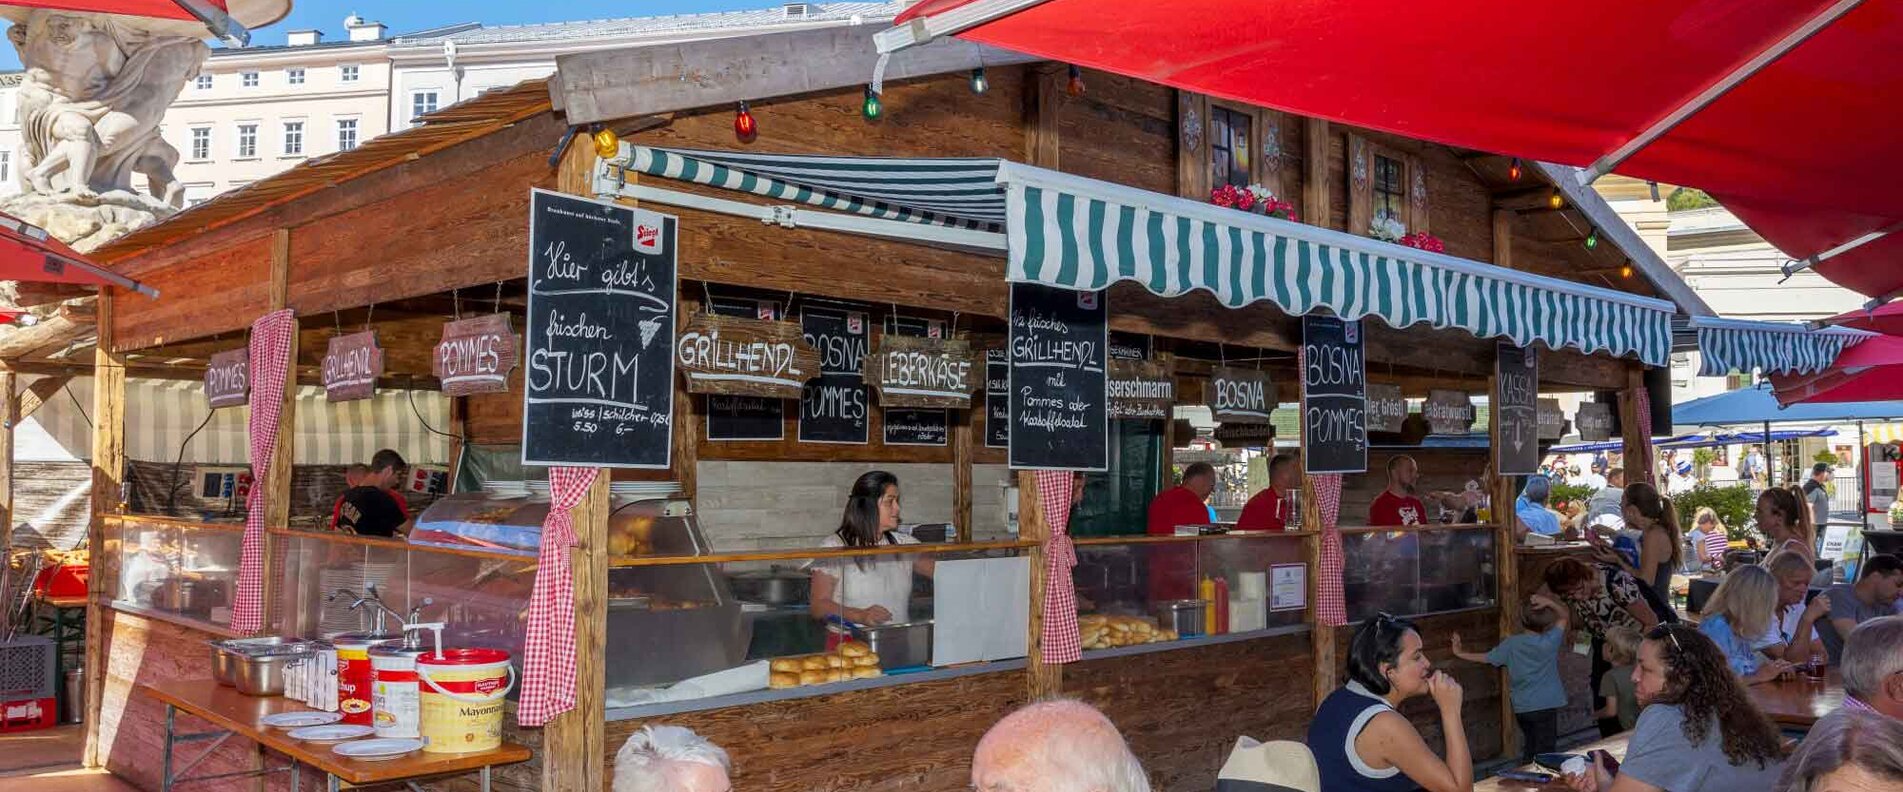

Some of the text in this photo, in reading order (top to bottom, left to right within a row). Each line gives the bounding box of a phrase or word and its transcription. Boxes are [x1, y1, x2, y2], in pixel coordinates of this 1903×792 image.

[544, 240, 655, 294] Hier gibt's
[546, 309, 613, 349] frischen
[1027, 307, 1068, 336] frisches
[440, 335, 500, 374] POMMES
[881, 351, 971, 390] LEBERKÄSE
[1307, 344, 1362, 386] BOSNA
[209, 362, 246, 390] POMMES
[529, 347, 640, 404] STURM
[1047, 371, 1066, 387] mit
[1500, 372, 1534, 404] KASSA
[801, 386, 864, 419] POMMES
[1020, 386, 1091, 411] Pommes oder
[1214, 378, 1266, 410] BOSNA
[1307, 406, 1364, 444] POMMES
